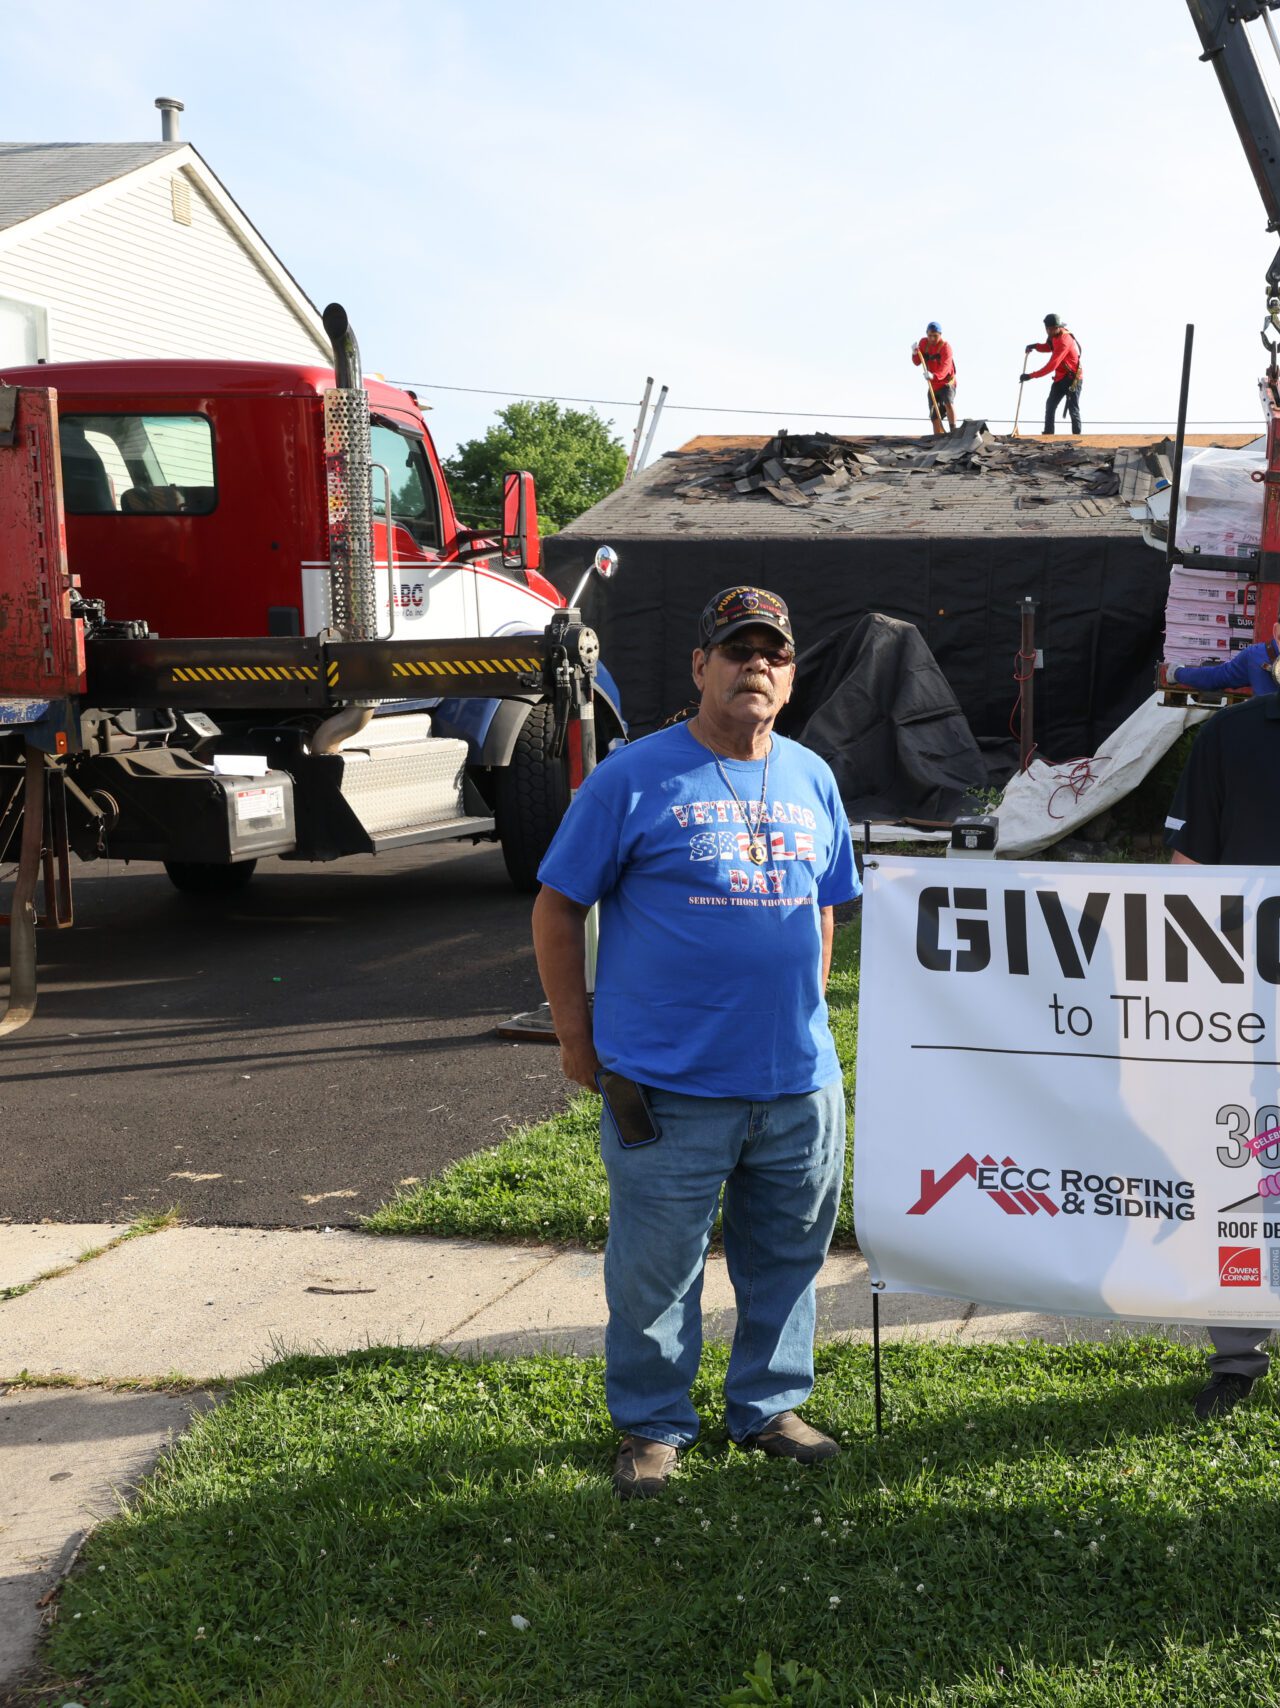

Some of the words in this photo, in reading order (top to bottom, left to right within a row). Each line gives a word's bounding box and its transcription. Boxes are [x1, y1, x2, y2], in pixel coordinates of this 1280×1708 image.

[752, 588, 782, 608] HEART
[672, 800, 817, 830] VETERANS
[729, 870, 787, 894] DAY
[688, 896, 728, 906] SERVING
[730, 897, 759, 907] THOSE
[1048, 992, 1093, 1037] to
[1110, 994, 1266, 1044] Those
[977, 1166, 1052, 1192] ECC
[1061, 1169, 1195, 1200] ROOFING
[1061, 1191, 1085, 1215] &
[1094, 1192, 1195, 1222] SIDING
[1217, 1221, 1259, 1239] ROOF
[1222, 1274, 1259, 1282] CORNING
[1228, 1266, 1259, 1274] OWENS
